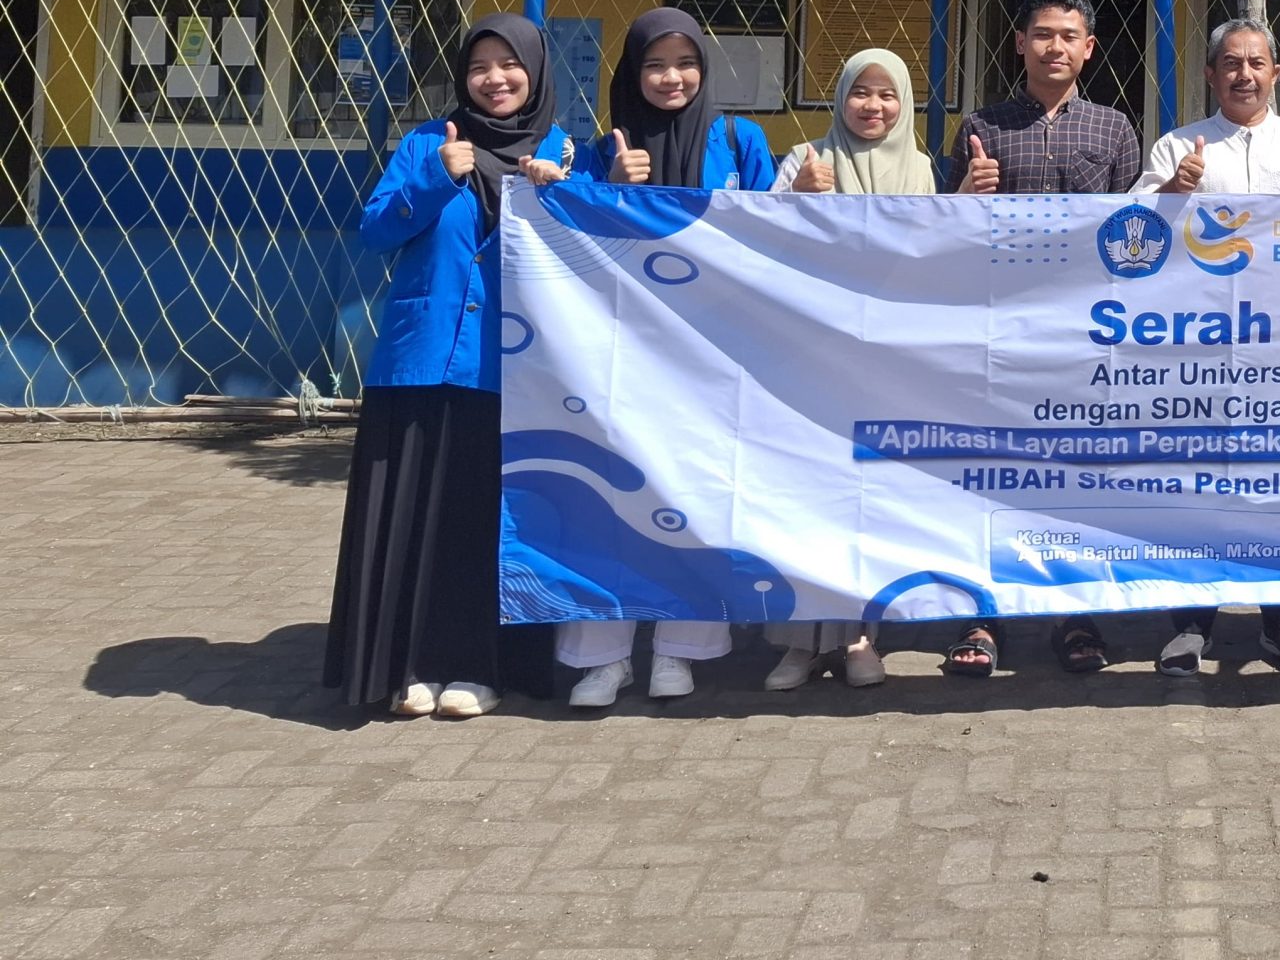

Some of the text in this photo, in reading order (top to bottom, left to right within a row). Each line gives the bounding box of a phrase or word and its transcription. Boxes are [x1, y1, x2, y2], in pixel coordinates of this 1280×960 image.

[1087, 299, 1272, 346] Serah
[1089, 363, 1170, 386] Antar
[1033, 399, 1141, 426] dengan
[1151, 396, 1213, 420] SDN
[864, 424, 998, 456] "Aplikasi
[1007, 430, 1130, 459] Layanan
[951, 467, 1067, 492] -HIBAH
[1077, 472, 1183, 494] Skema
[1016, 530, 1080, 545] Ketua:
[1083, 545, 1139, 562] Baitul
[1143, 544, 1220, 562] Hikmah,
